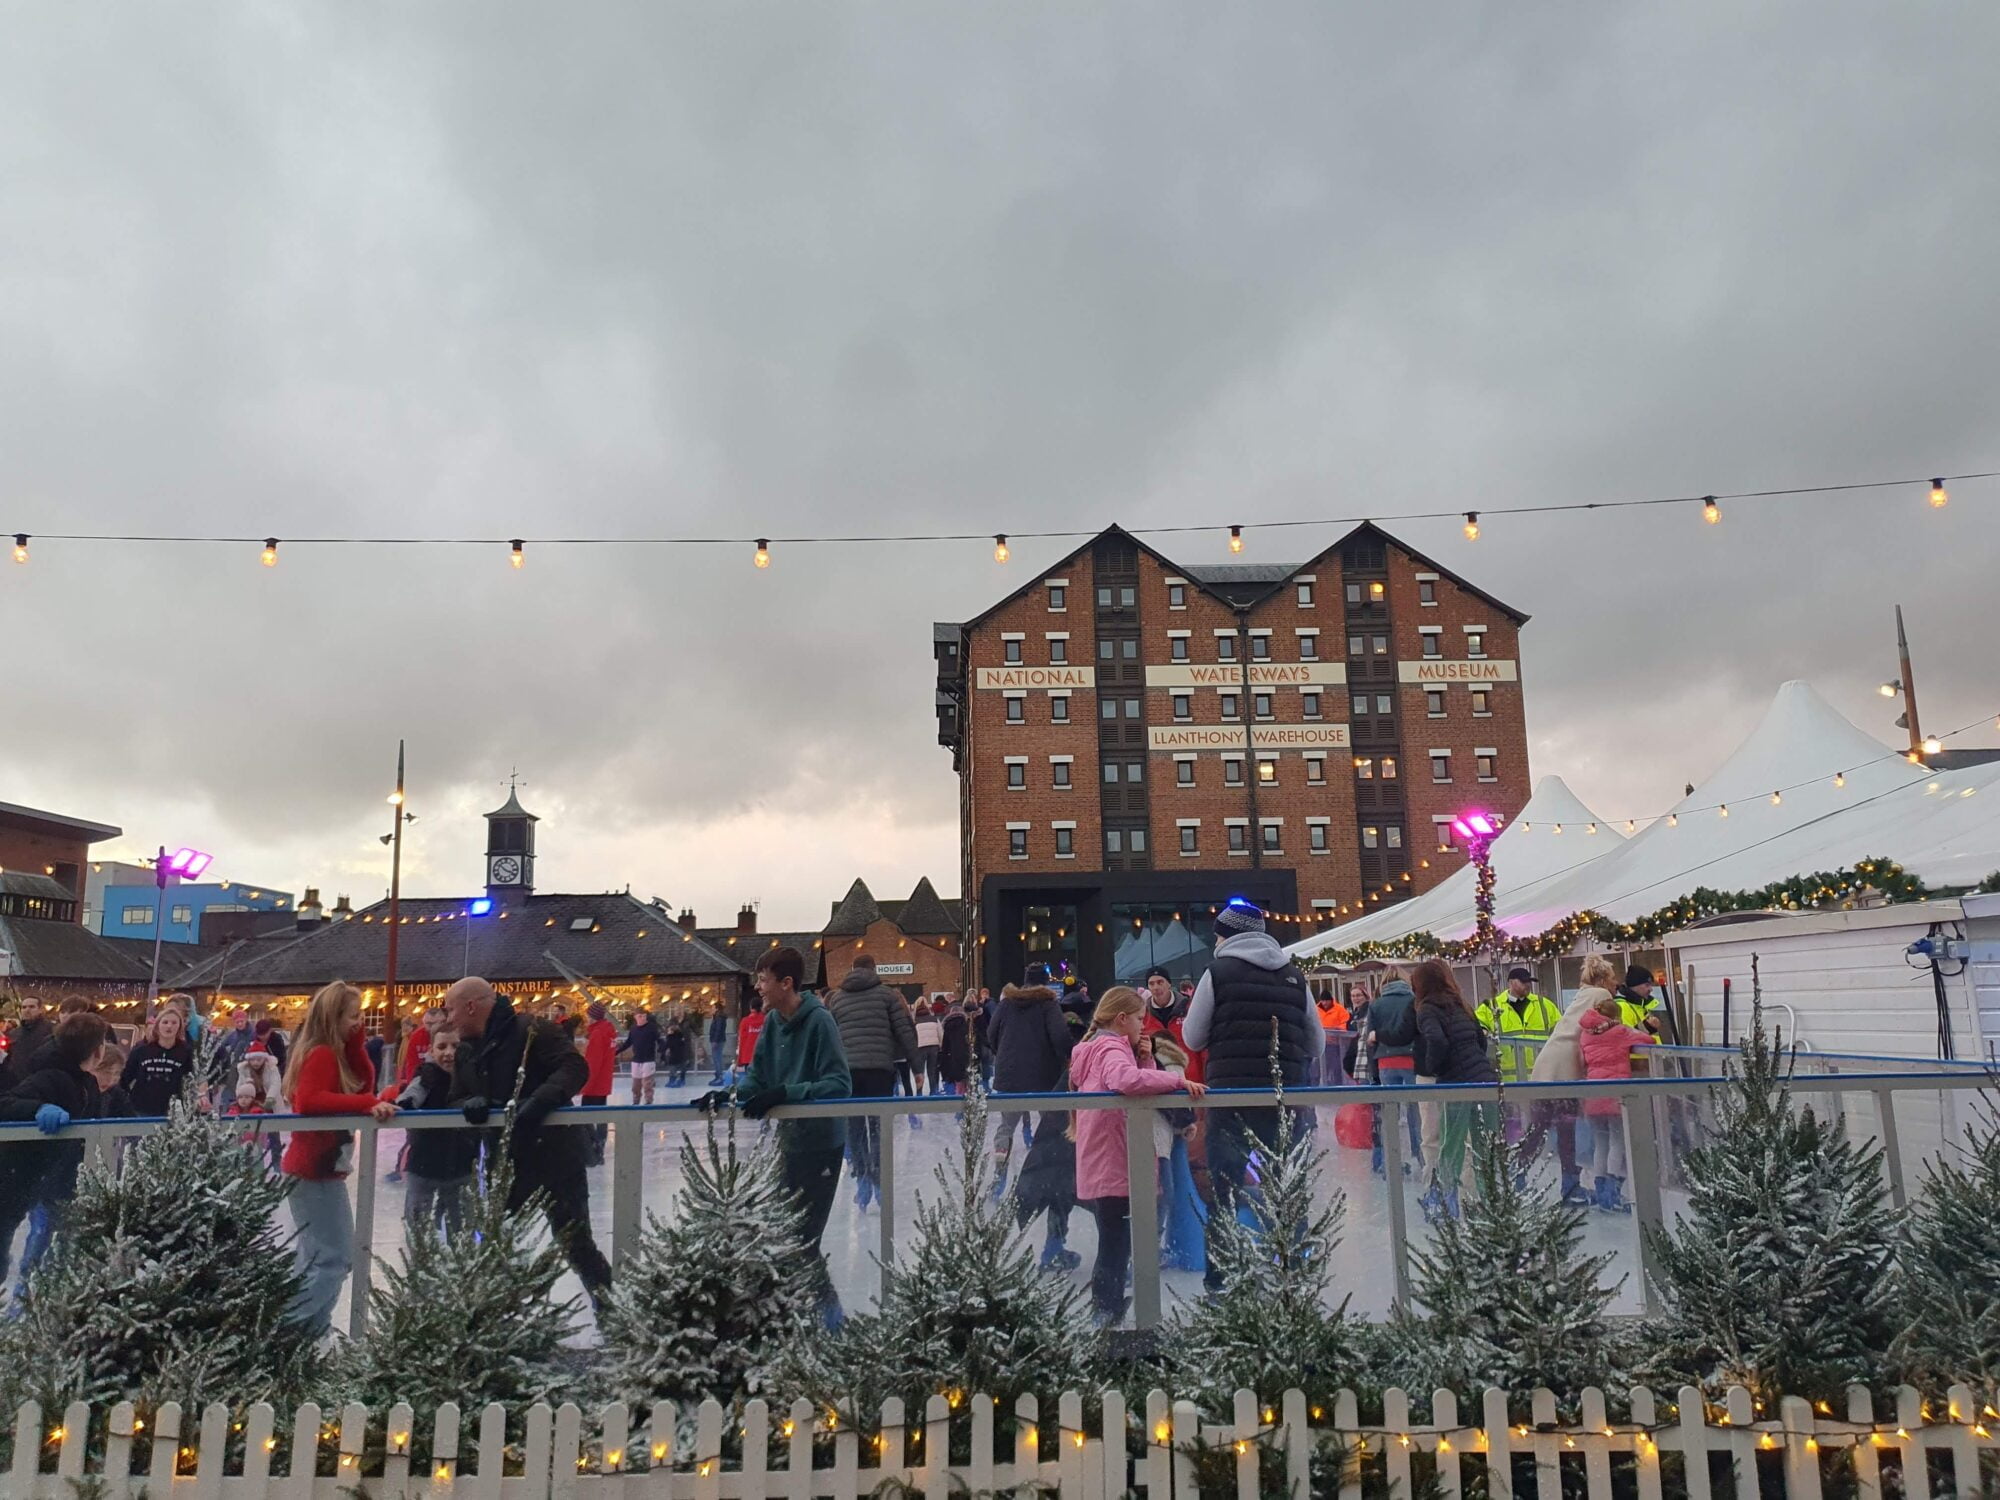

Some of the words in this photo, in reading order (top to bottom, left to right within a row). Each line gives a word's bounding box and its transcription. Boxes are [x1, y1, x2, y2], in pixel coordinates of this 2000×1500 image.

[986, 670, 1086, 686] NATIONAL
[1190, 666, 1311, 683] WATERWAYS
[1418, 663, 1500, 678] MUSEUM
[1154, 730, 1244, 745] LLANTHONY
[1252, 729, 1344, 744] WAREHOUSE
[410, 983, 441, 995] LORD
[490, 981, 551, 993] ONSTABLE
